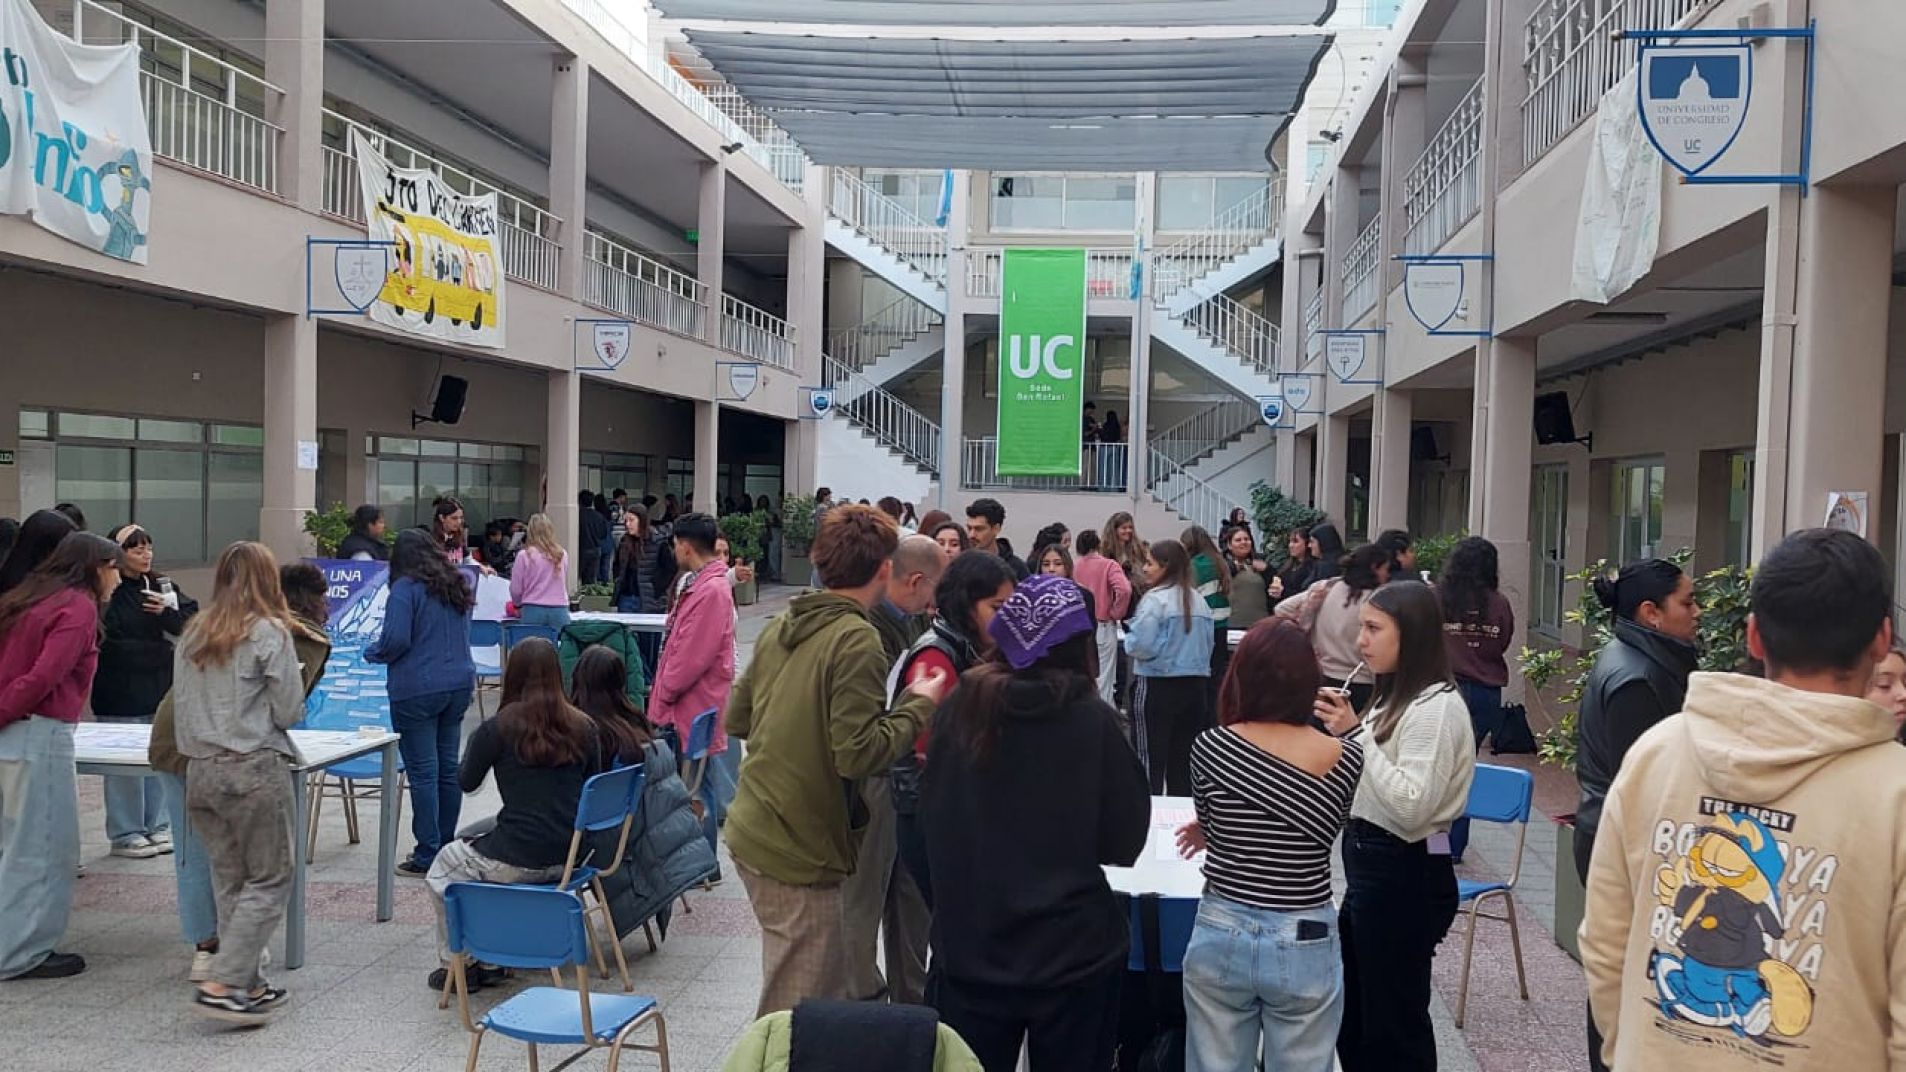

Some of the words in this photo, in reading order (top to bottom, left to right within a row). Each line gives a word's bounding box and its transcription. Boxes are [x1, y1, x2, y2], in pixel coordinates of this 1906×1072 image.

[1658, 104, 1730, 114] UNIVERSIDAD
[1658, 116, 1669, 125] DE
[1673, 115, 1730, 125] CONGRESO
[1684, 139, 1702, 151] UC
[1009, 334, 1074, 379] UC
[330, 570, 361, 582] UNA
